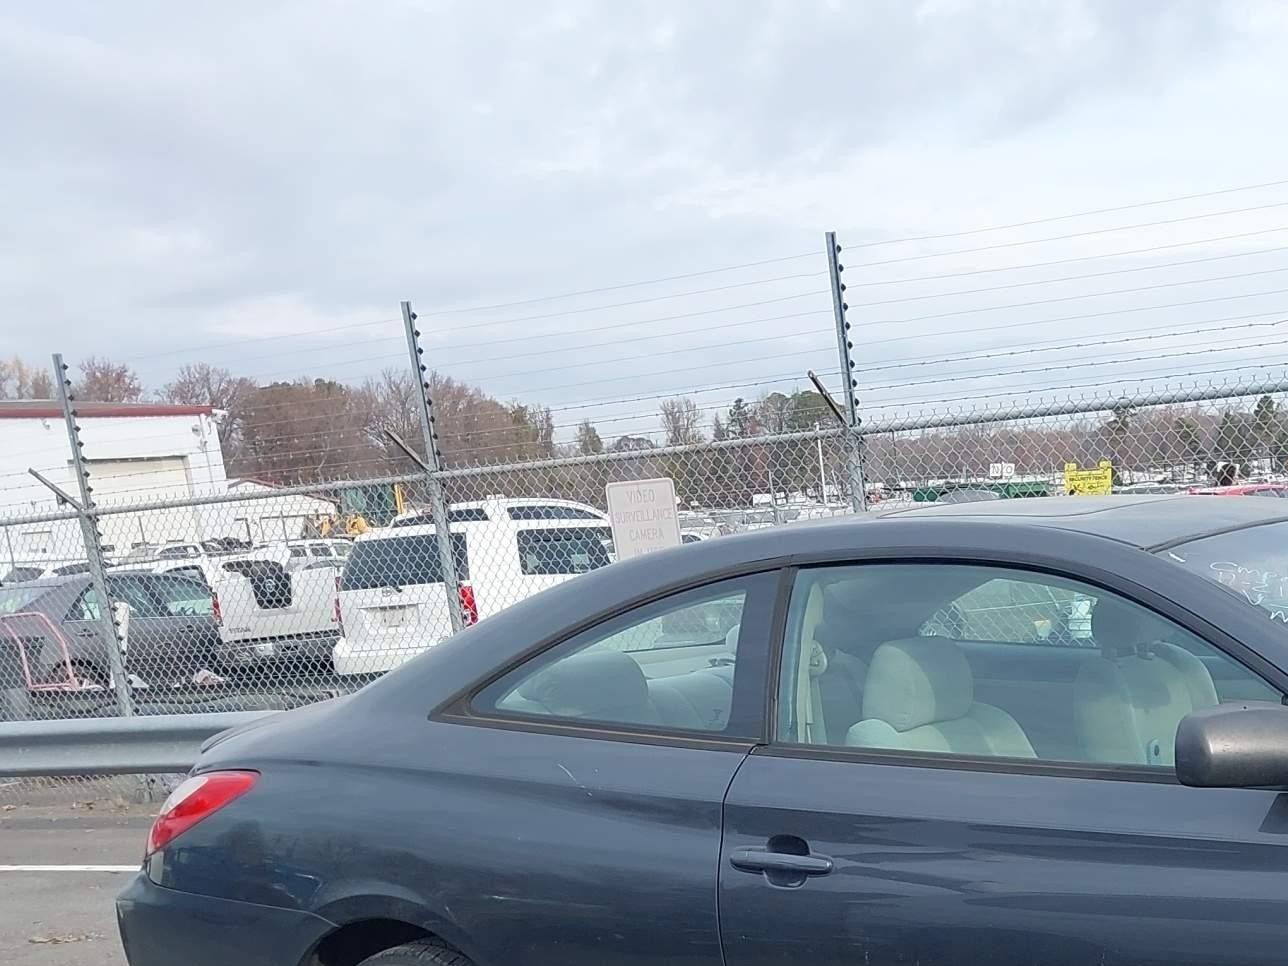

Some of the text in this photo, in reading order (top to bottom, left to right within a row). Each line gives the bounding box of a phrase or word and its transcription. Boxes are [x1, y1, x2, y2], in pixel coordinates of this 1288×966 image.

[625, 487, 656, 505] VIDEO
[614, 507, 674, 524] SURVEILLANCE
[629, 527, 665, 542] CAMERA
